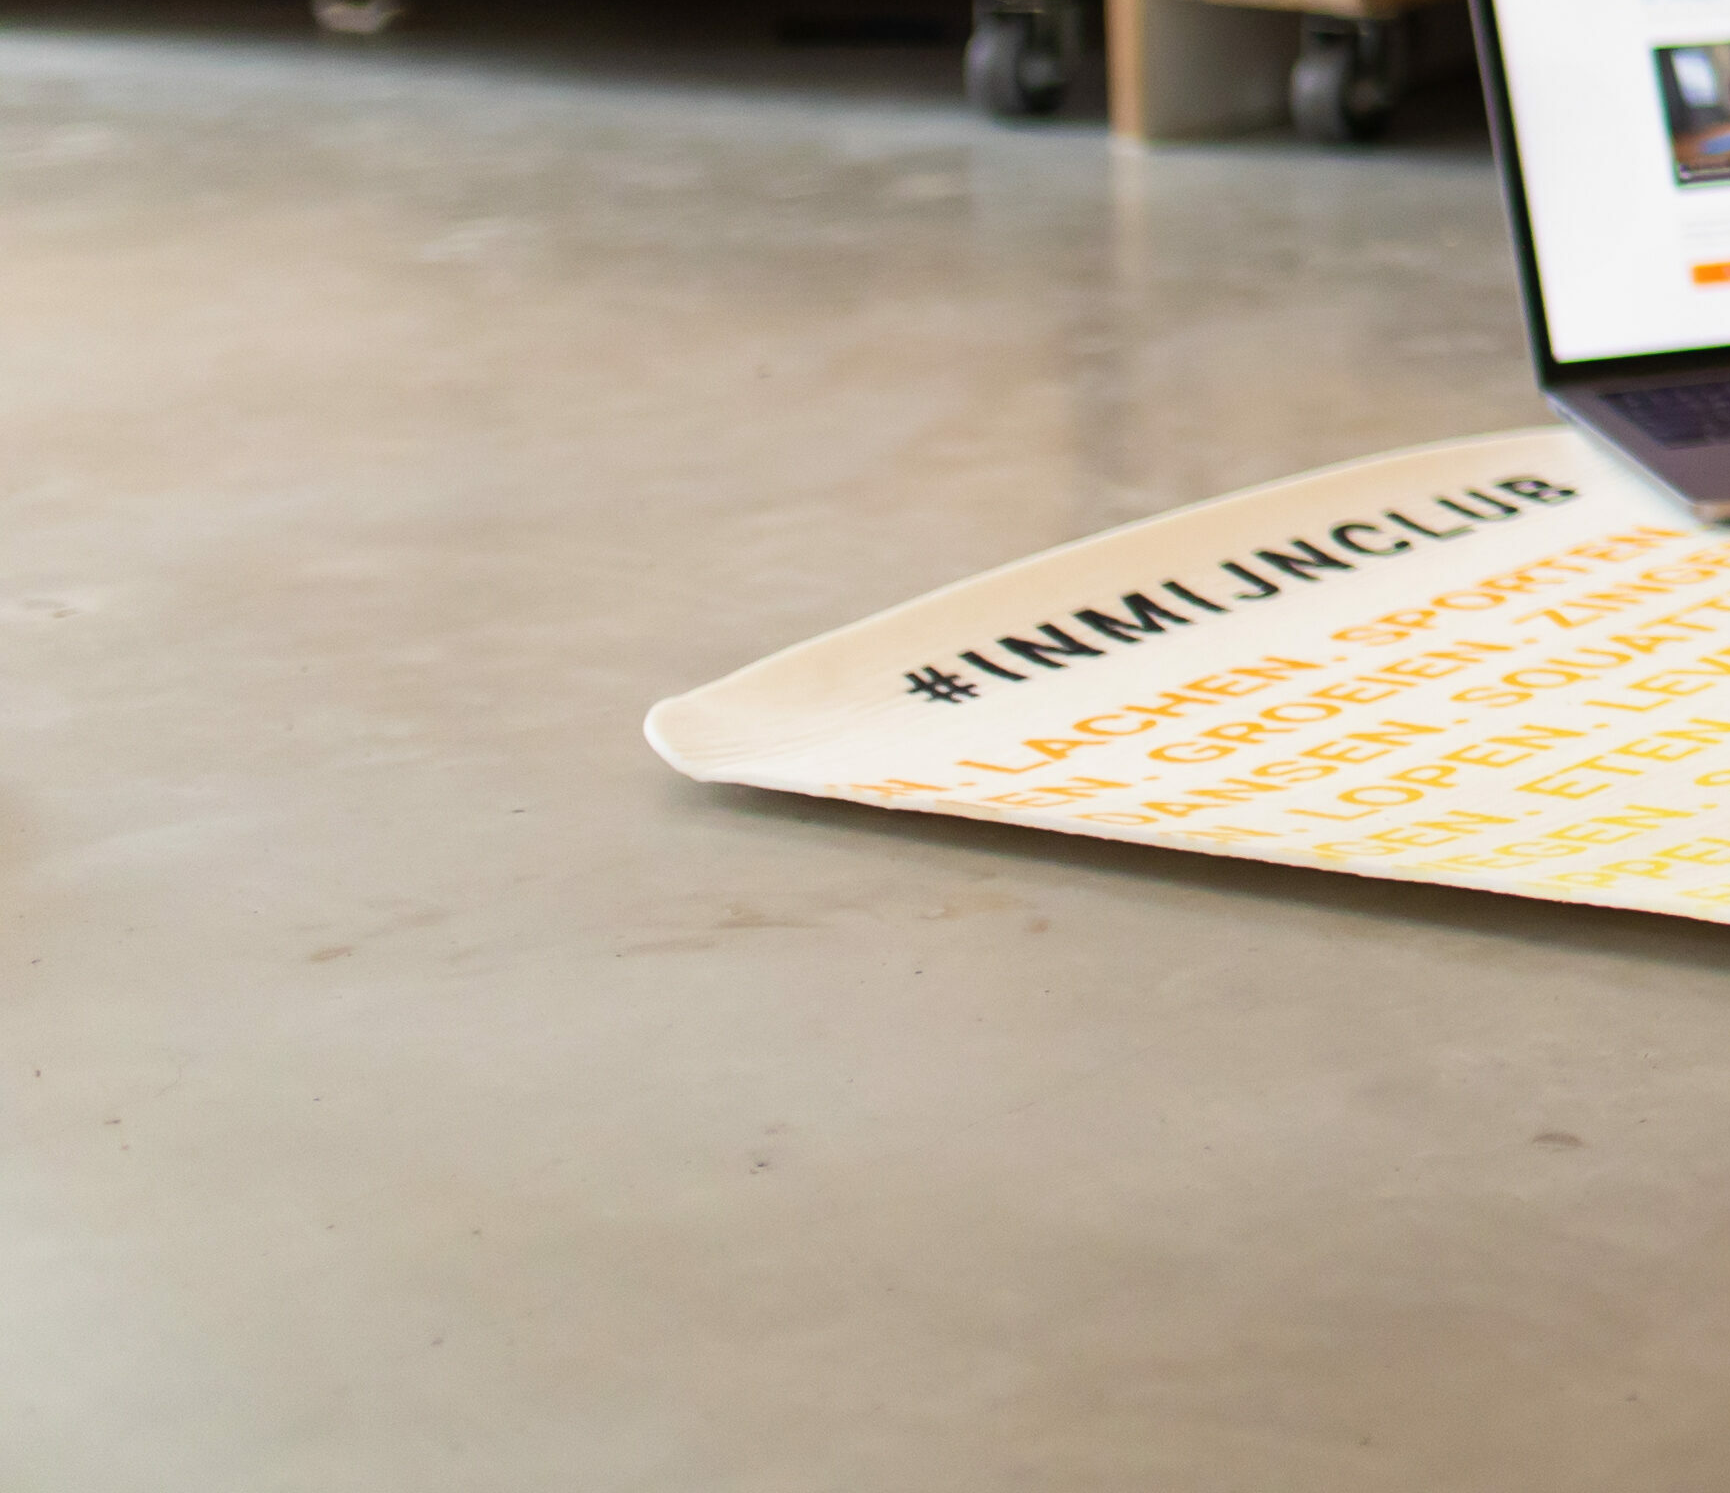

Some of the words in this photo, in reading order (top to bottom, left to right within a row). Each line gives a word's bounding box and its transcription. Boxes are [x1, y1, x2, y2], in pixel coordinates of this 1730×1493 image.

[903, 474, 1579, 704] #INMIJNCLUB
[956, 655, 1348, 774] LACHEN.
[1147, 637, 1539, 763] GROEIEN.
[1072, 718, 1469, 826] DANSEN.
[1284, 722, 1609, 821] LOPEN.
